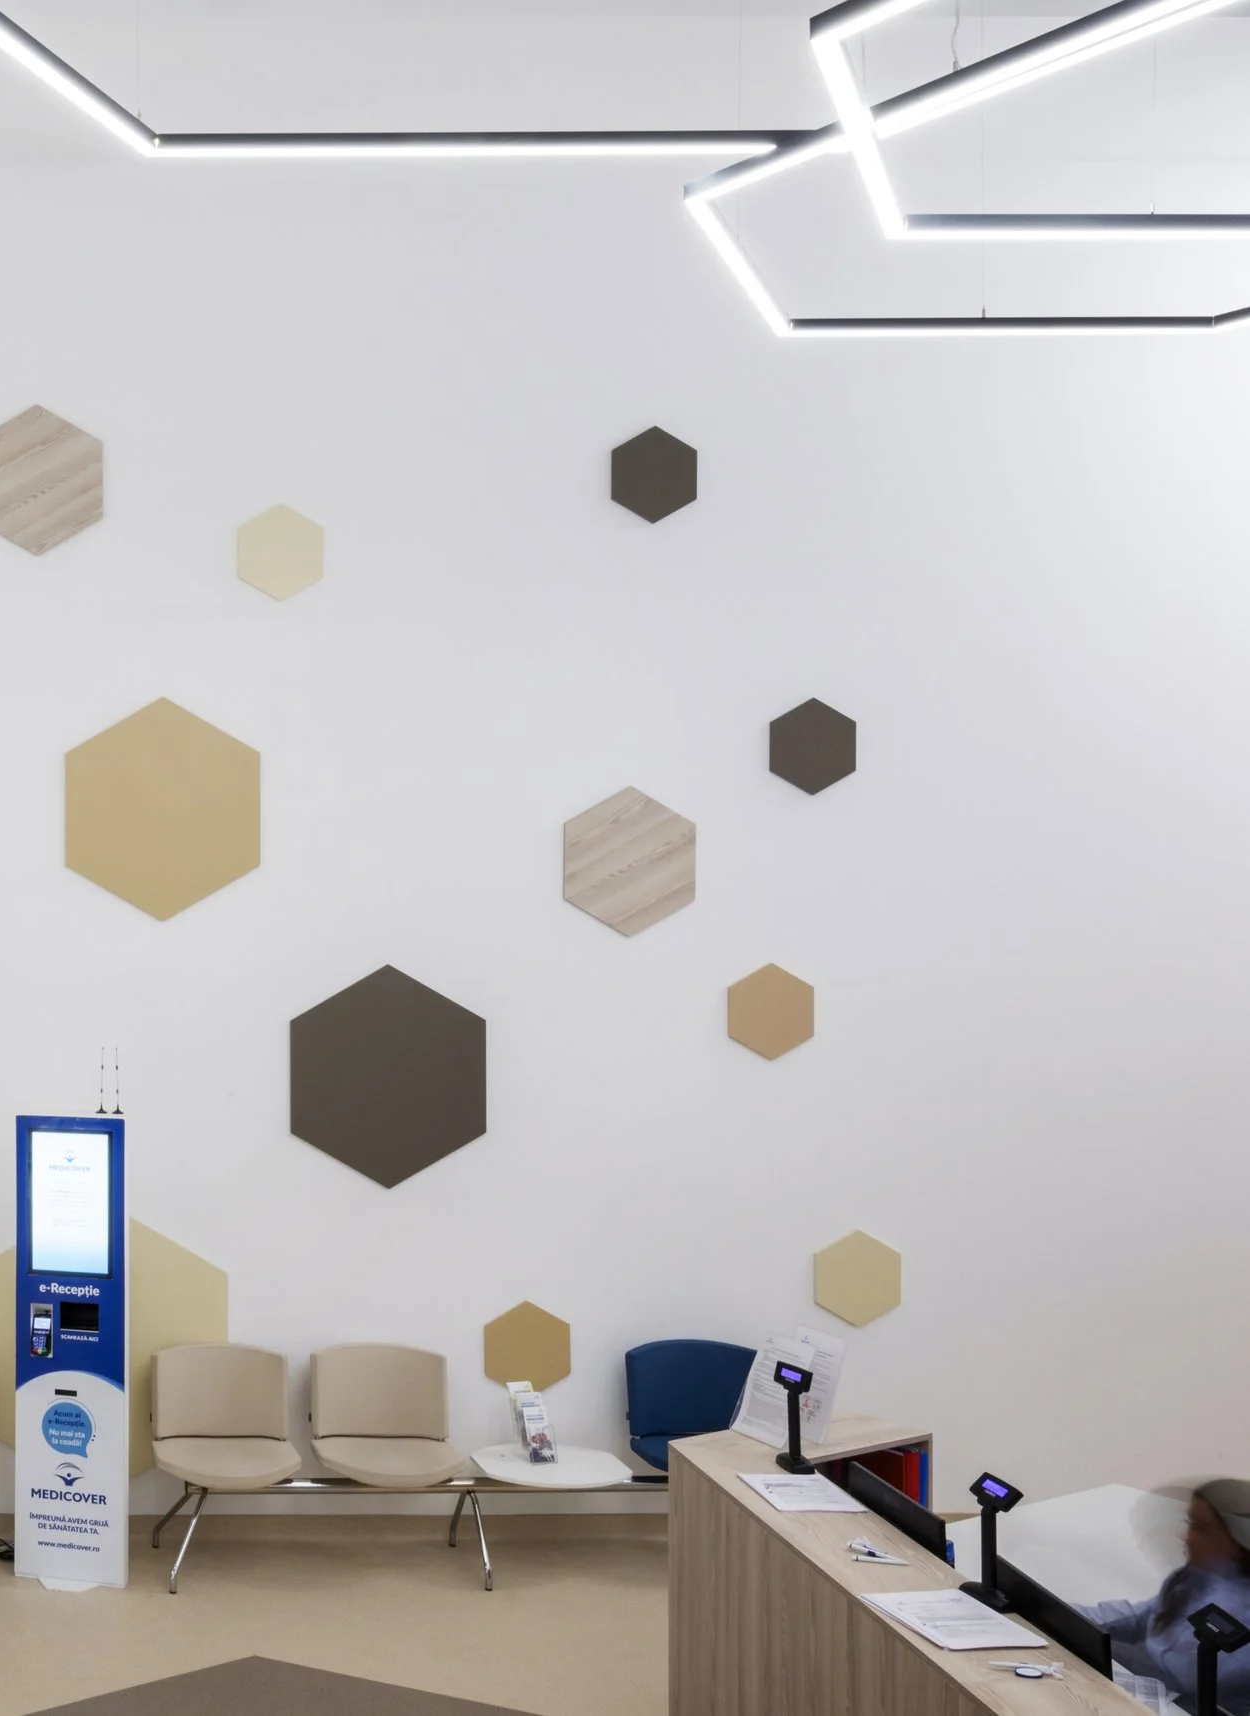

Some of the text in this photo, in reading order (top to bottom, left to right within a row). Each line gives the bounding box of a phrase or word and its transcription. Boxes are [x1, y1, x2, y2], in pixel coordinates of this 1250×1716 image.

[49, 1164, 91, 1172] MEDICOVER
[39, 1282, 100, 1298] e-Recepție
[53, 1410, 74, 1418] Acum
[49, 1428, 60, 1436] Nu
[61, 1429, 74, 1437] mai
[31, 1488, 107, 1505] MEDICOVER
[29, 1512, 109, 1527] ÎMPREUNĂ AVEM GRIJĂ
[48, 1523, 89, 1534] SĂNĂTATEA
[37, 1540, 100, 1552] www.medicover.ro
